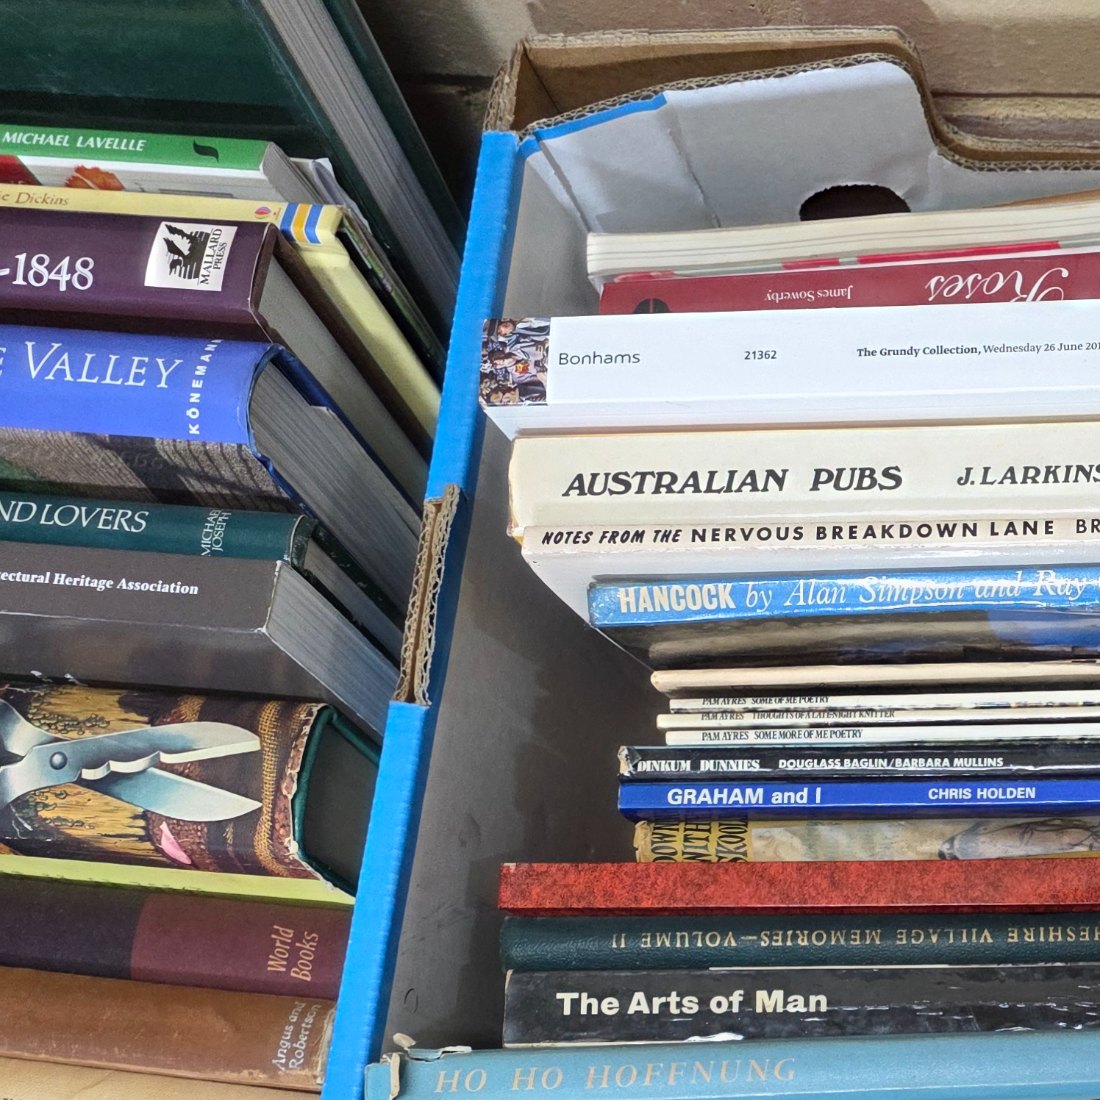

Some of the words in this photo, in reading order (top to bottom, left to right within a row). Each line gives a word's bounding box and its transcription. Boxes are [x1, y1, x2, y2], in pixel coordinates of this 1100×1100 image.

[2, 131, 70, 147] MICHAEL
[15, 191, 69, 207] Dickins
[199, 227, 223, 286] MALLARD
[212, 241, 227, 272] PRESS
[765, 289, 815, 303] Sowerby
[817, 284, 853, 301] James
[24, 341, 184, 389] VALLEY
[558, 350, 641, 366] Bonhams
[744, 349, 777, 361] 21362
[856, 347, 878, 358] The
[880, 345, 920, 359] Grundy
[922, 343, 982, 356] Collection,
[983, 342, 1042, 355] Wednesday
[1044, 342, 1056, 352] 26
[1057, 341, 1083, 352] June
[562, 468, 789, 497] AUSTRALIAN
[810, 465, 903, 492] PUBS
[40, 504, 149, 533] LOVERS
[541, 529, 593, 545] NOTES
[599, 529, 645, 544] FROM
[652, 529, 682, 543] THE
[691, 526, 804, 542] NERVOUS
[815, 520, 978, 541] BREAKDOWN
[990, 519, 1055, 537] LANE
[53, 573, 114, 592] Heritage
[117, 578, 199, 596] Association
[619, 583, 736, 613] HANCOCK
[745, 582, 773, 612] by
[784, 578, 846, 607] Alan
[859, 572, 965, 603] Simpson
[699, 758, 761, 772] DUNNIES
[778, 758, 841, 770] DOUGLASS
[952, 756, 1004, 769] MULLINS
[667, 788, 764, 806] GRAHAM
[771, 787, 809, 804] and
[815, 787, 822, 804] I
[928, 787, 972, 800] CHRIS
[977, 786, 1036, 800] HOLDEN
[268, 925, 294, 972] World
[896, 927, 993, 945] VILLAGE
[291, 931, 319, 982] Books
[556, 992, 620, 1016] The
[628, 991, 699, 1015] Arts
[710, 990, 744, 1013] of
[755, 990, 828, 1014] Man
[435, 1068, 487, 1093] HO
[512, 1066, 564, 1091] HO
[585, 1057, 796, 1089] HOFFNUNG
